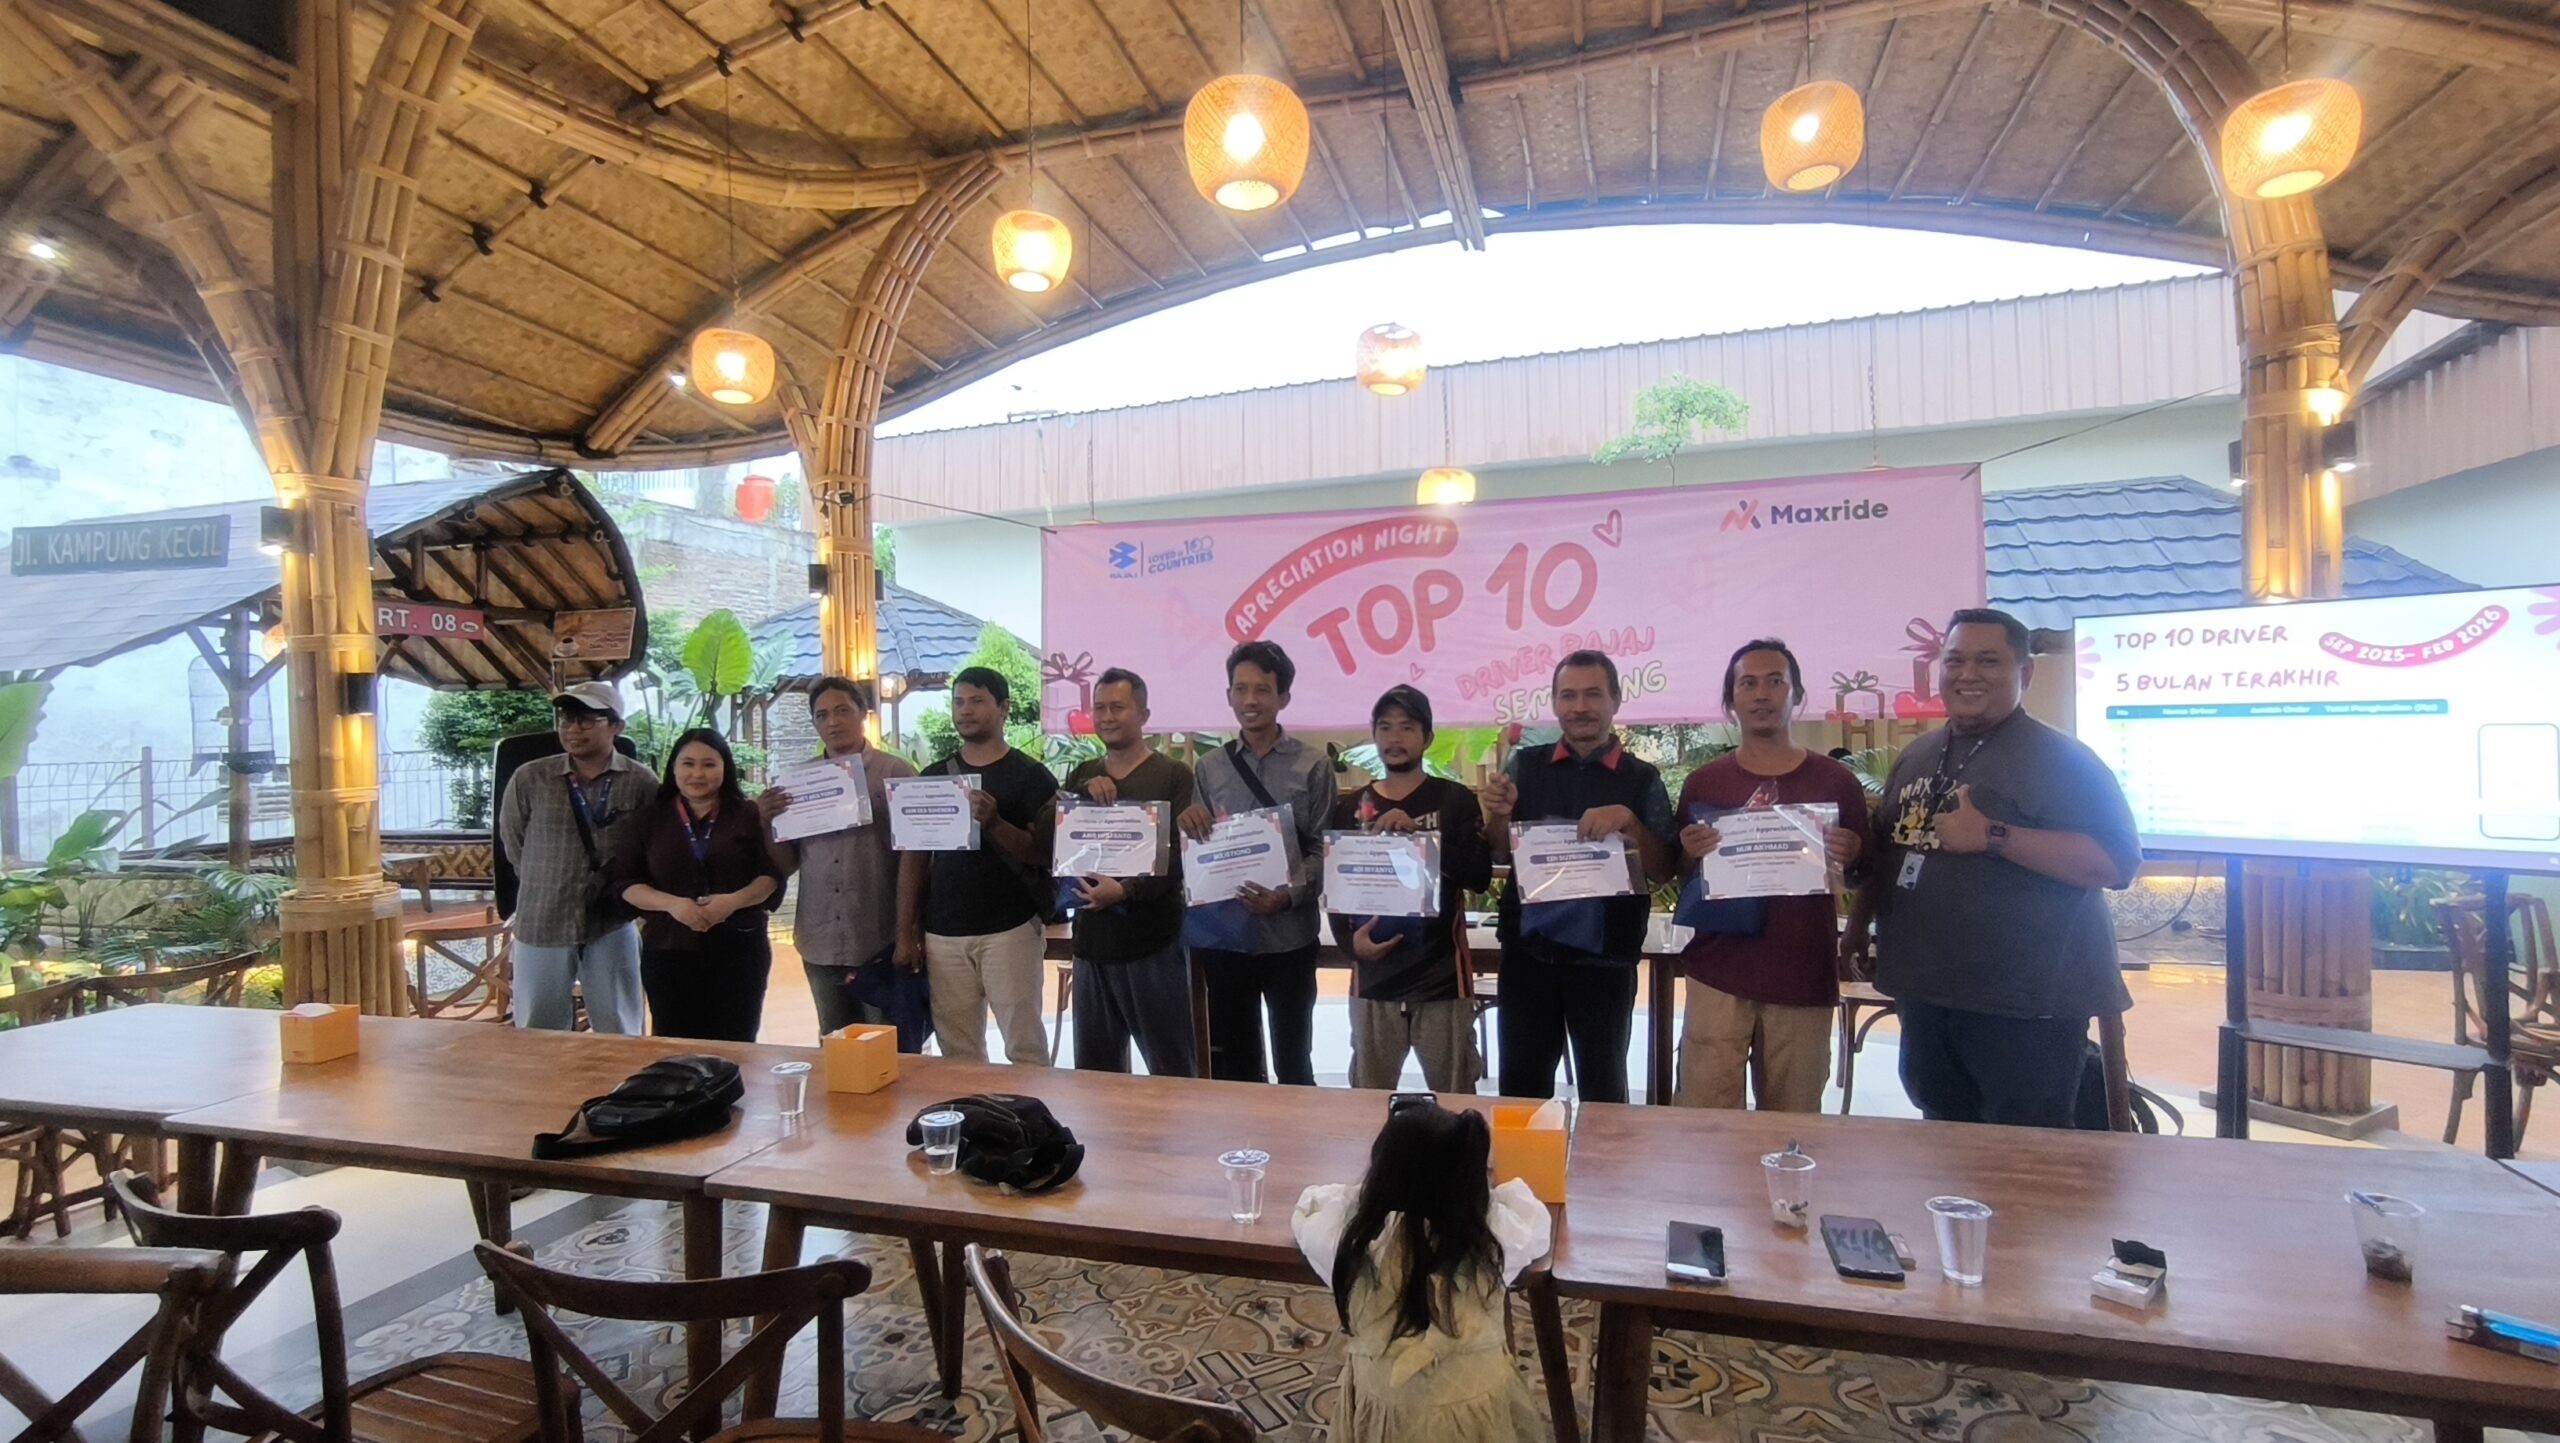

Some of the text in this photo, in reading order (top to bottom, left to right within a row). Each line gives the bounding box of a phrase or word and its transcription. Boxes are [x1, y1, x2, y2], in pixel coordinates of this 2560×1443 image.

[1771, 499, 1888, 525] Maxride
[48, 528, 151, 565] KAMPUNG
[159, 523, 222, 559] KECIL
[1148, 550, 1214, 574] COUNTRIES
[1235, 524, 1448, 635] APRECIATION NIGHT
[378, 607, 418, 629] RT.
[431, 613, 457, 632] 08
[1306, 542, 1598, 676] TOP 10
[2113, 625, 2288, 650] TOP 10 DRIVER
[2324, 636, 2354, 654] SEP
[2456, 609, 2501, 644] 2026
[1455, 626, 1655, 700] DRIVER BAJAJ
[2116, 668, 2340, 692] 5 BULAN TERAKHIR
[1493, 660, 1667, 725] SEMNG
